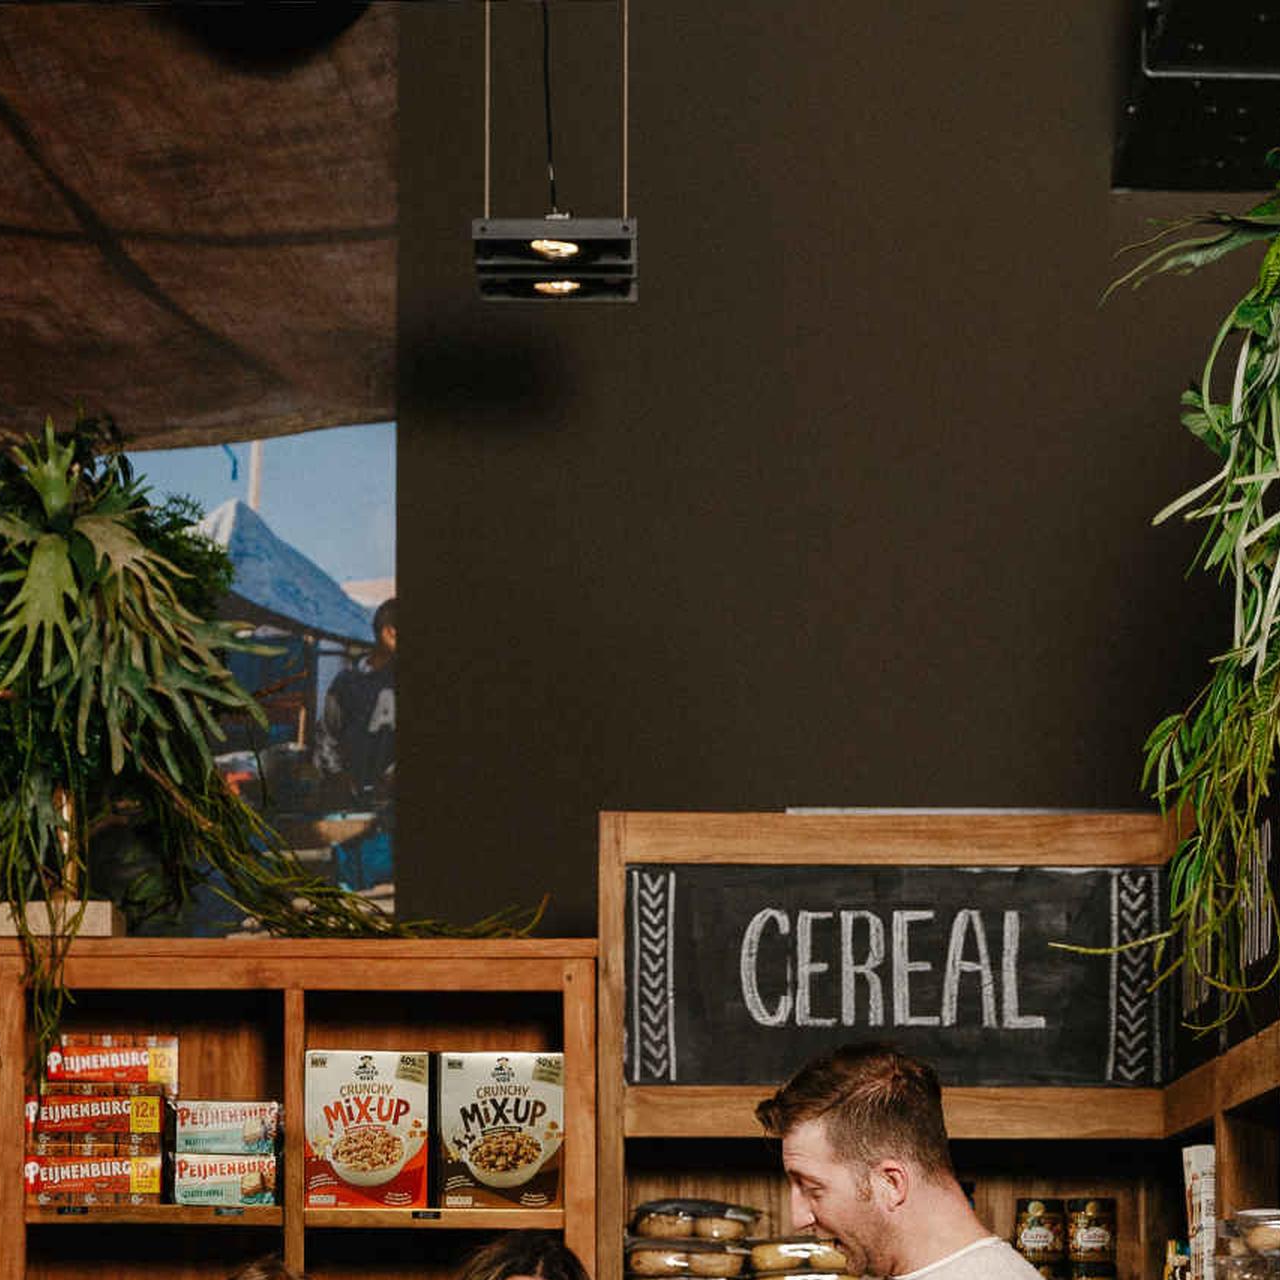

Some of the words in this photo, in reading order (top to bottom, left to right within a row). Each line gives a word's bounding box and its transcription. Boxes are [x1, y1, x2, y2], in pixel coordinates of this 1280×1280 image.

[741, 908, 1046, 1029] CEREAL
[340, 1083, 394, 1097] CRUNCHY
[476, 1084, 530, 1098] CRUNCHY
[25, 1160, 132, 1184] PEIJNENBURG
